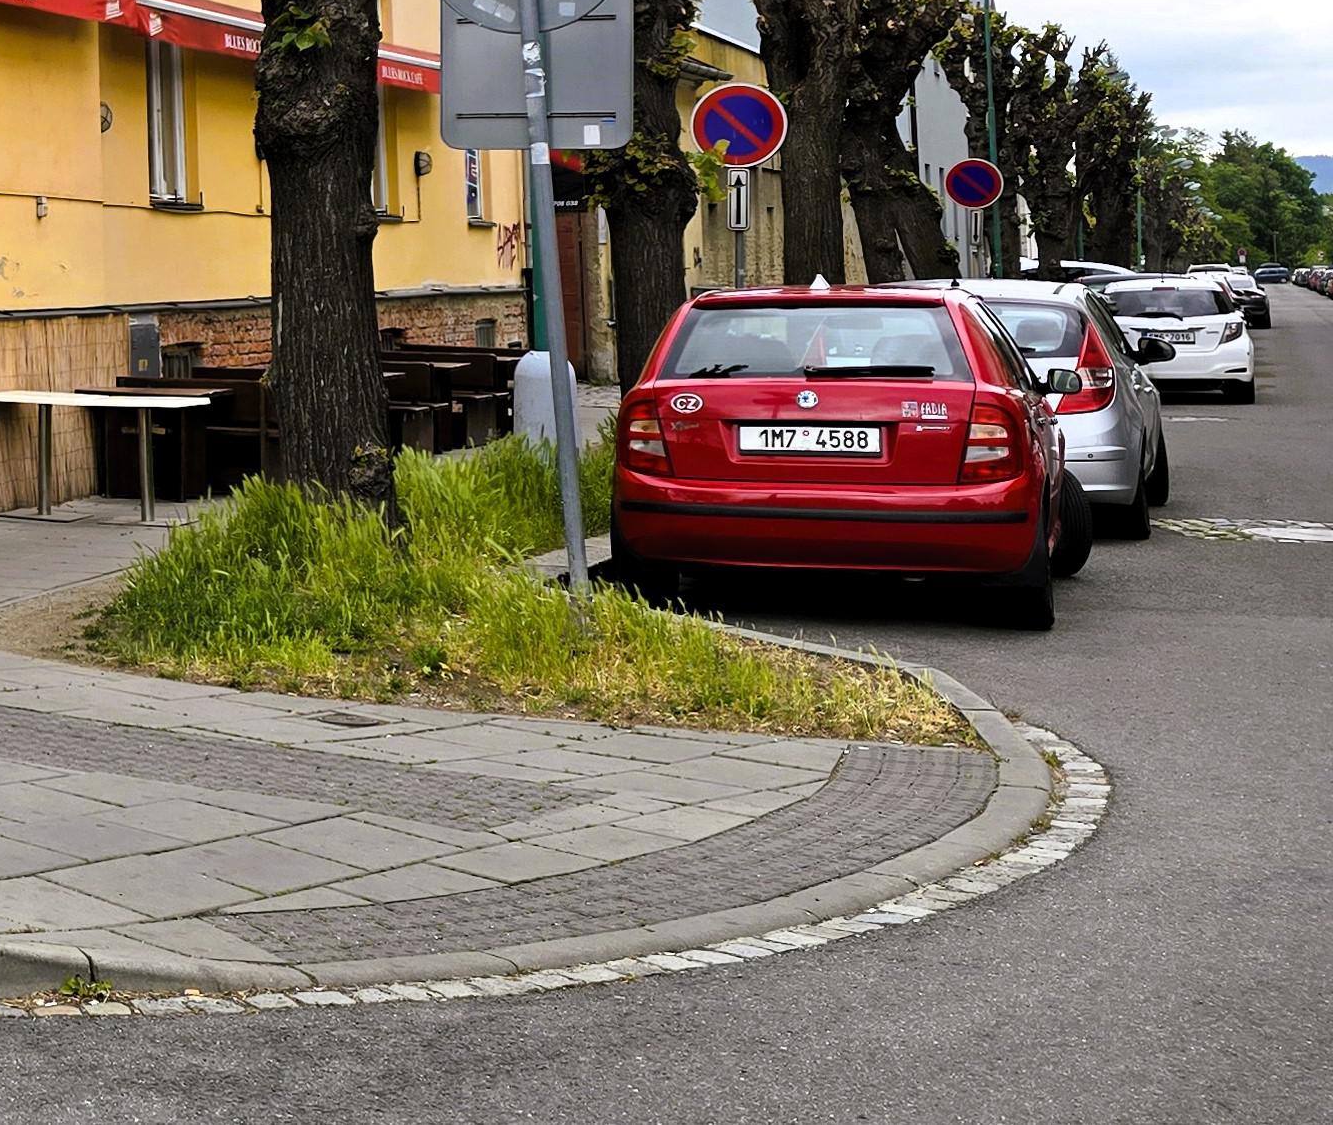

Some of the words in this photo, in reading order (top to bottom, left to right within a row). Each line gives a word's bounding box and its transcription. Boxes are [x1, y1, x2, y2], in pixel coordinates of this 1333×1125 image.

[245, 37, 262, 54] ROC
[675, 398, 697, 410] CZ
[759, 429, 797, 449] 1M7
[815, 430, 869, 449] 4588
